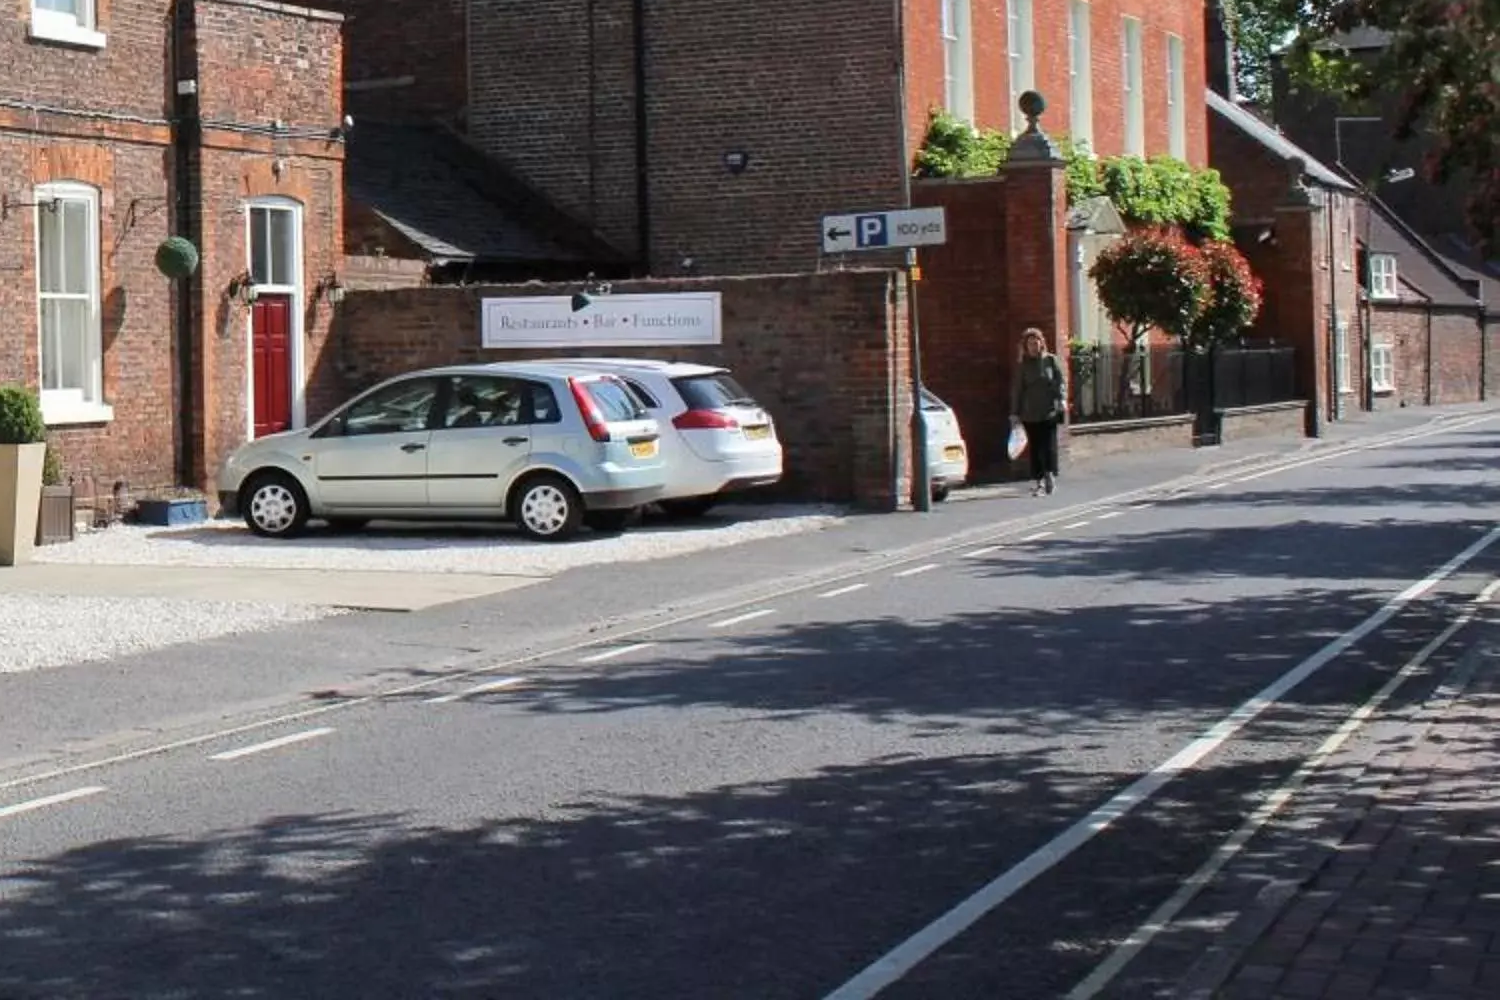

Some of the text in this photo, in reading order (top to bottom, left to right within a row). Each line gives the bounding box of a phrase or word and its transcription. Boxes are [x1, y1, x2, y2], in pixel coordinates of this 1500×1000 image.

[861, 217, 882, 245] P
[896, 223, 919, 235] 100
[593, 313, 616, 328] Bar
[633, 313, 702, 328] Functions
